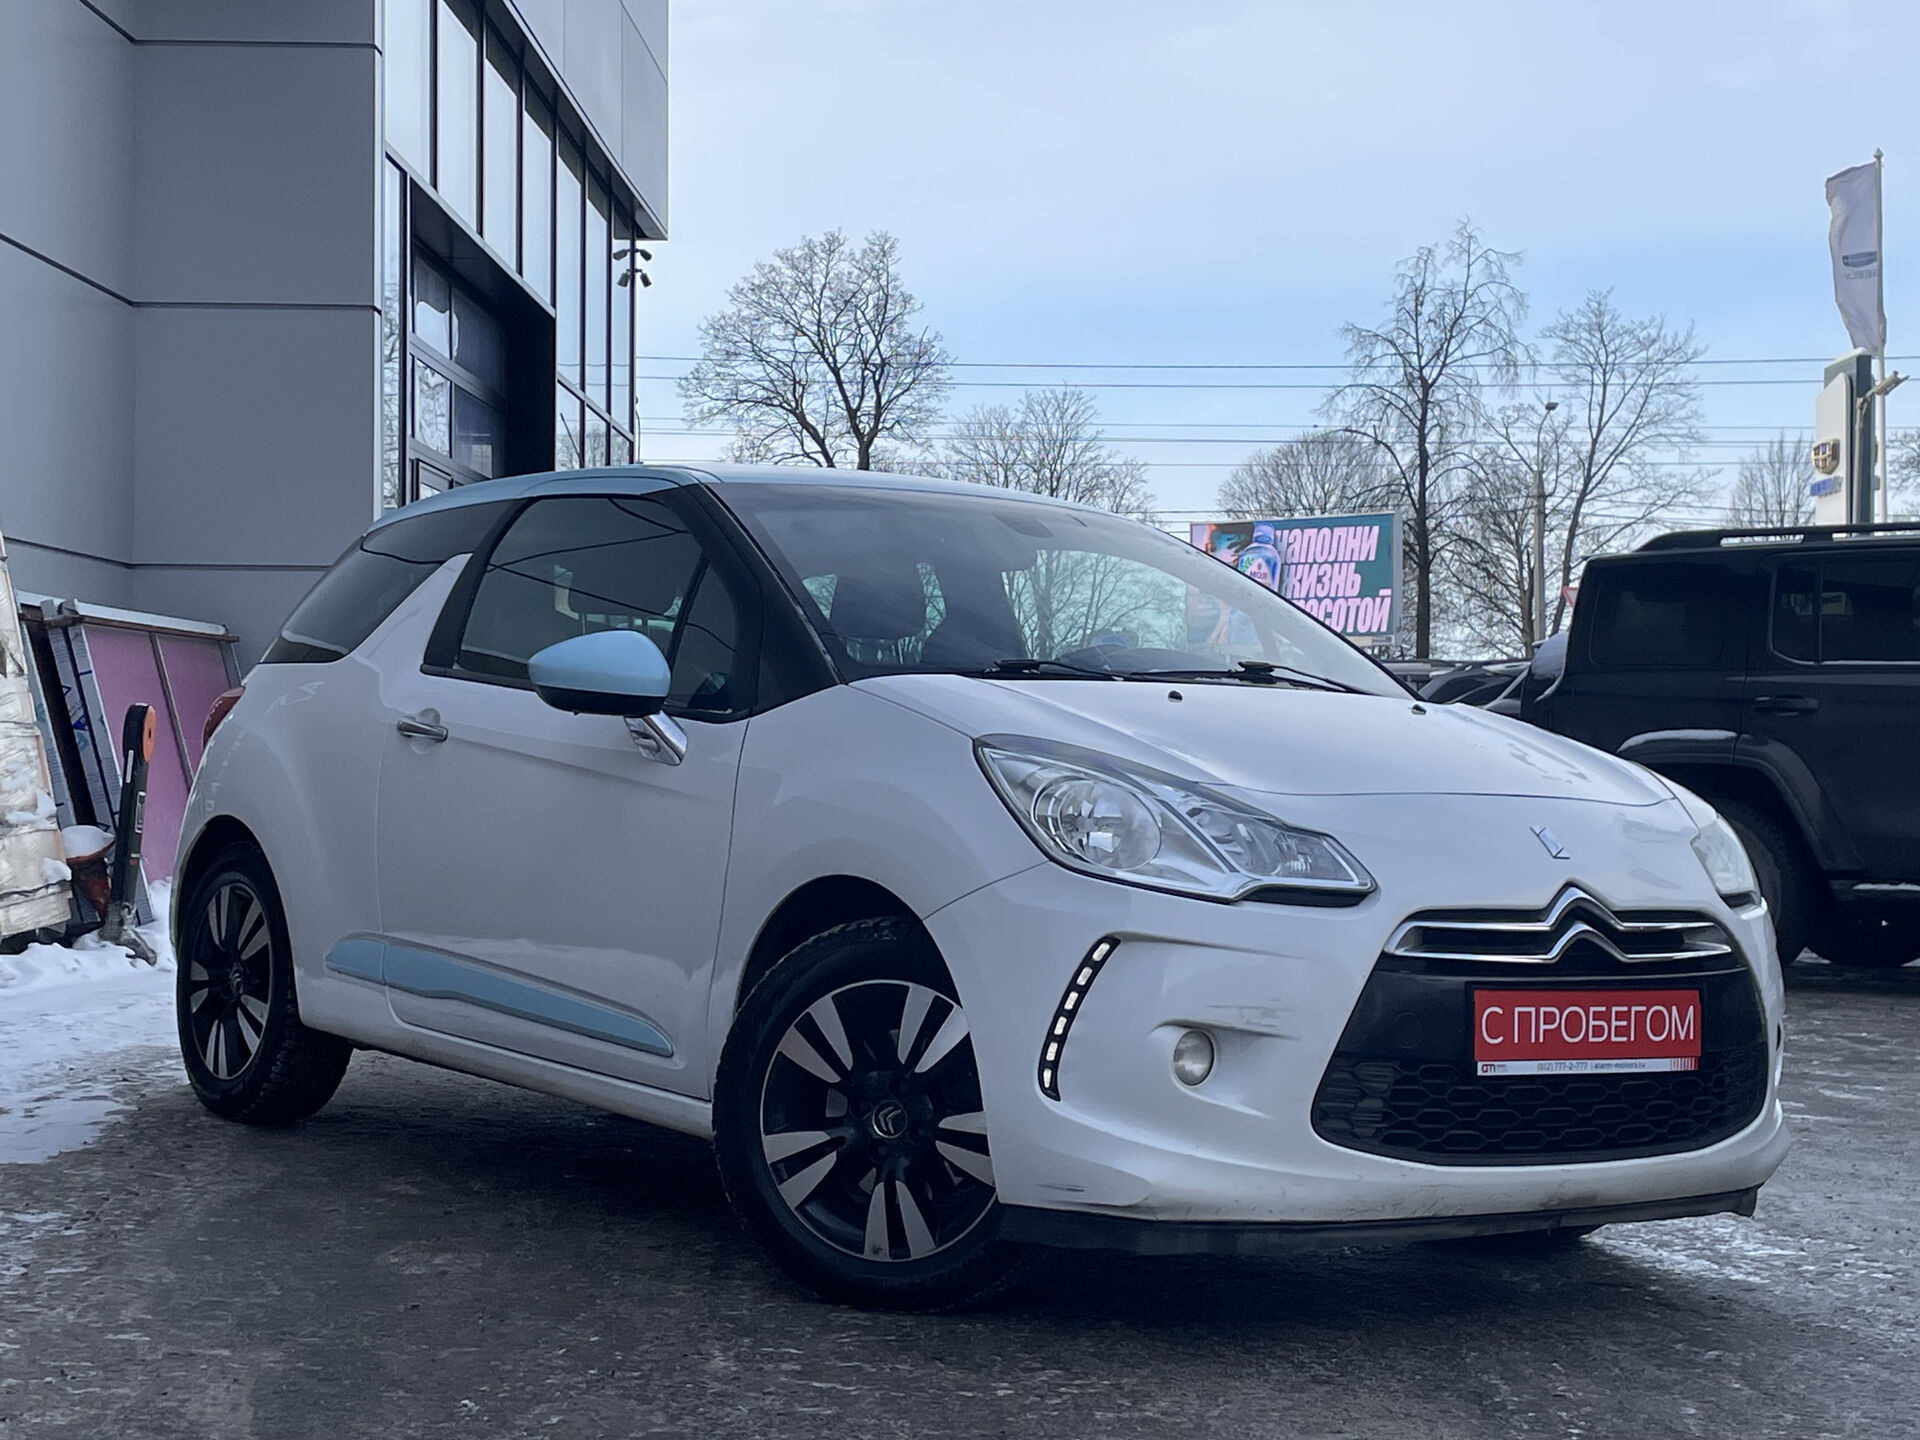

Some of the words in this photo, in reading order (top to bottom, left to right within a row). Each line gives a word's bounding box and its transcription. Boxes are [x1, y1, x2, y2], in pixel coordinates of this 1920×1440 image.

[1282, 562, 1361, 599] ЖИЗНЬ
[1481, 1006, 1504, 1044] С
[1513, 1005, 1694, 1044] ПРОБЕГОМ
